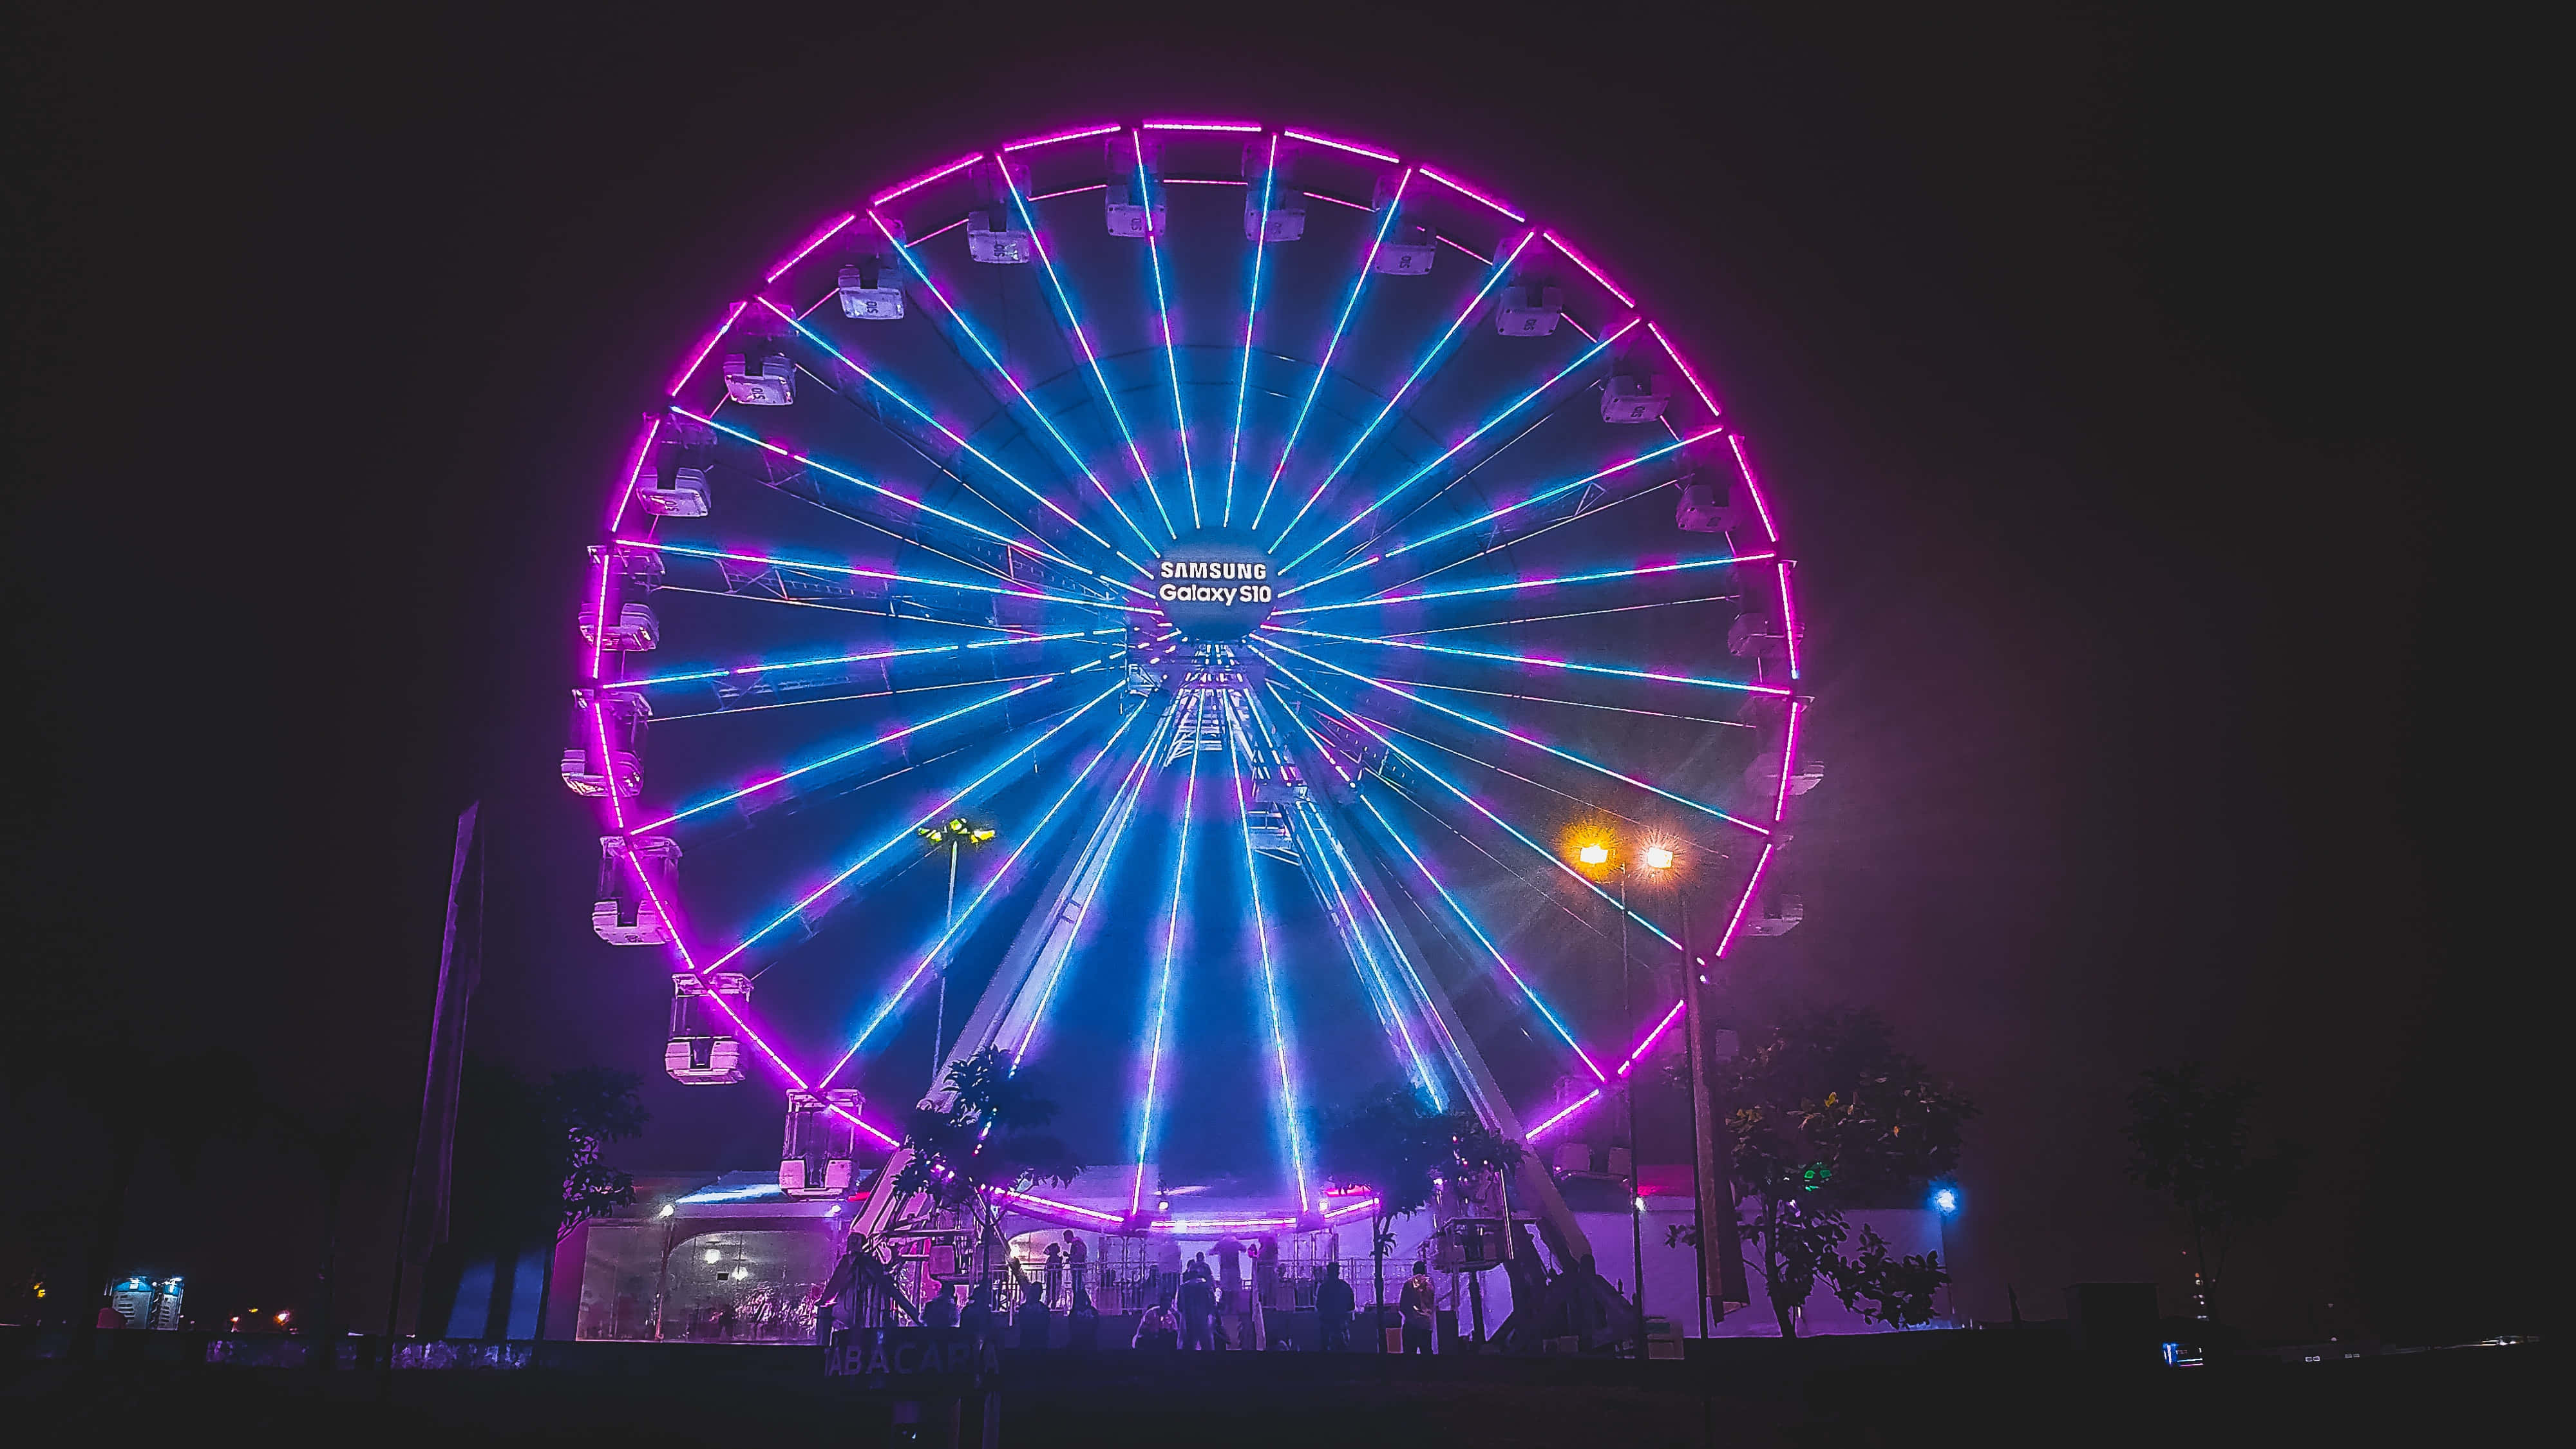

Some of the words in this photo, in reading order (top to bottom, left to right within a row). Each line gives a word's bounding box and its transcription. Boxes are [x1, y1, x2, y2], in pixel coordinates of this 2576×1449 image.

[1160, 562, 1267, 580] SAMSUNG
[1159, 583, 1237, 606] Galaxy
[1240, 585, 1271, 603] S10
